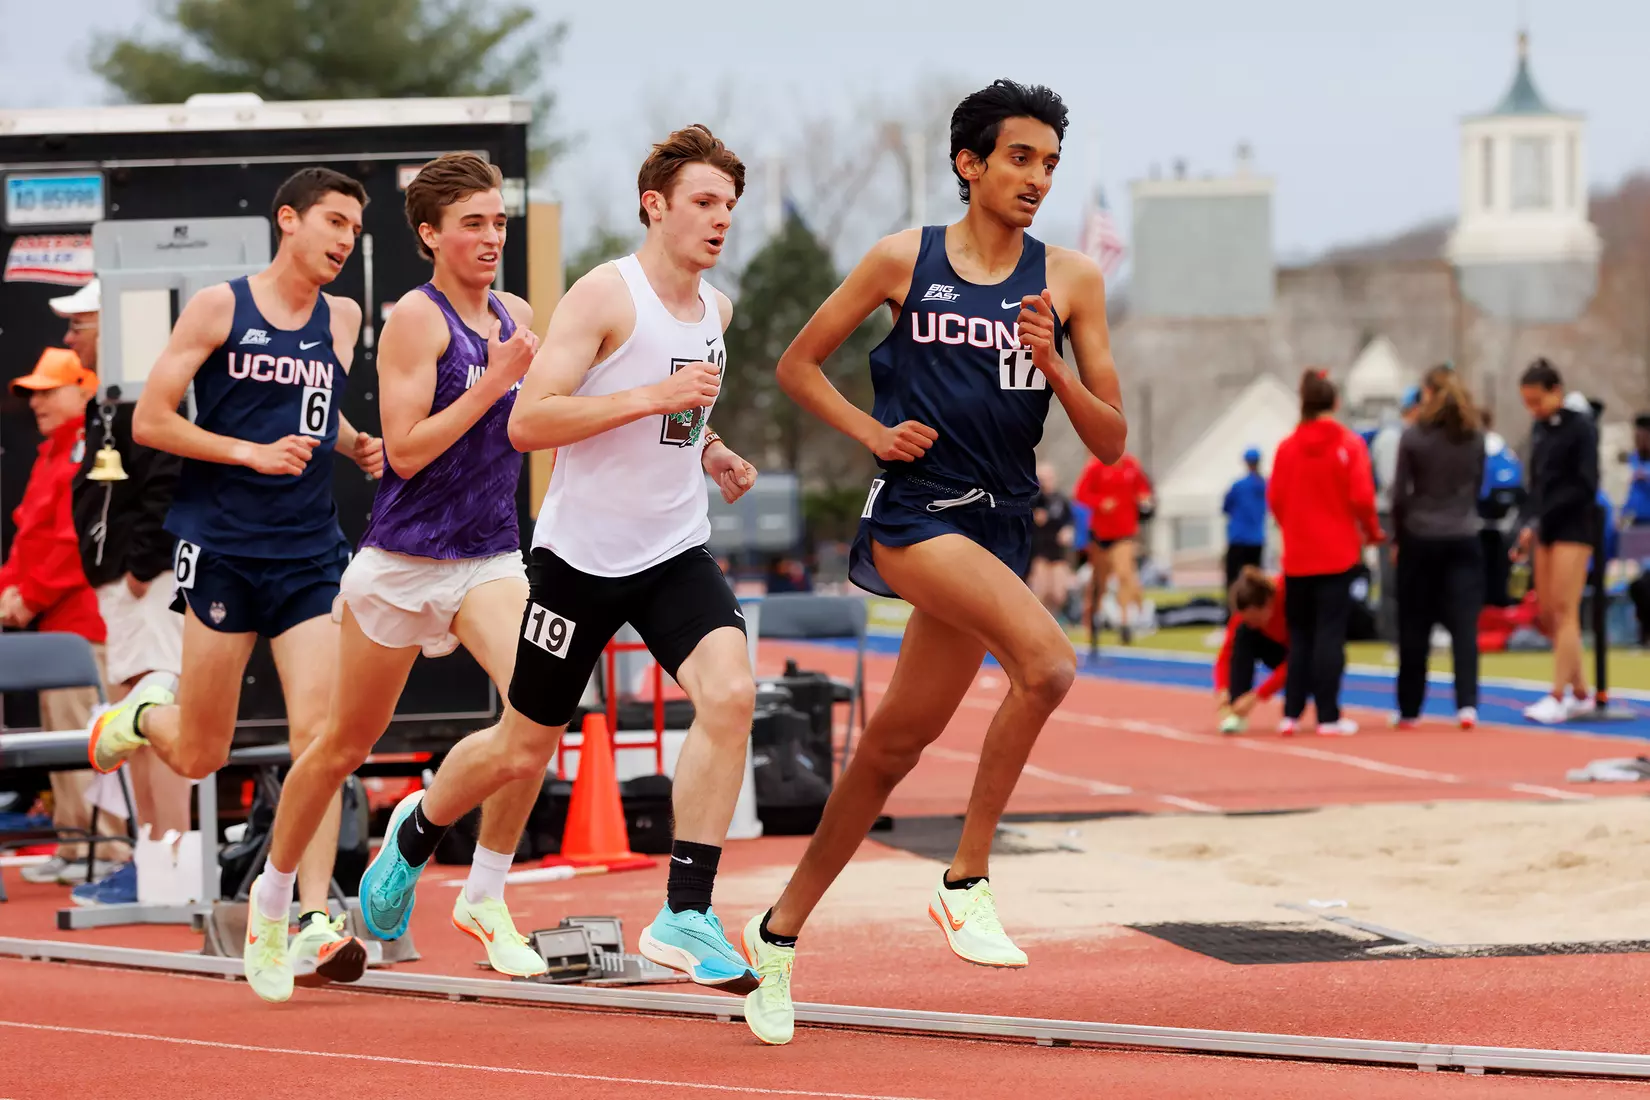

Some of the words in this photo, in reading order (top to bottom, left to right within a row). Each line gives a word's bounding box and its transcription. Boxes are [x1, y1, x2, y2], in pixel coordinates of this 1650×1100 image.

[924, 291, 961, 300] EAST
[929, 284, 955, 292] BIG
[911, 312, 1032, 350] UCON
[228, 352, 334, 389] UCONN
[1004, 351, 1038, 388] 17
[306, 391, 327, 432] 6
[176, 543, 193, 583] 6
[532, 609, 567, 652] 19
